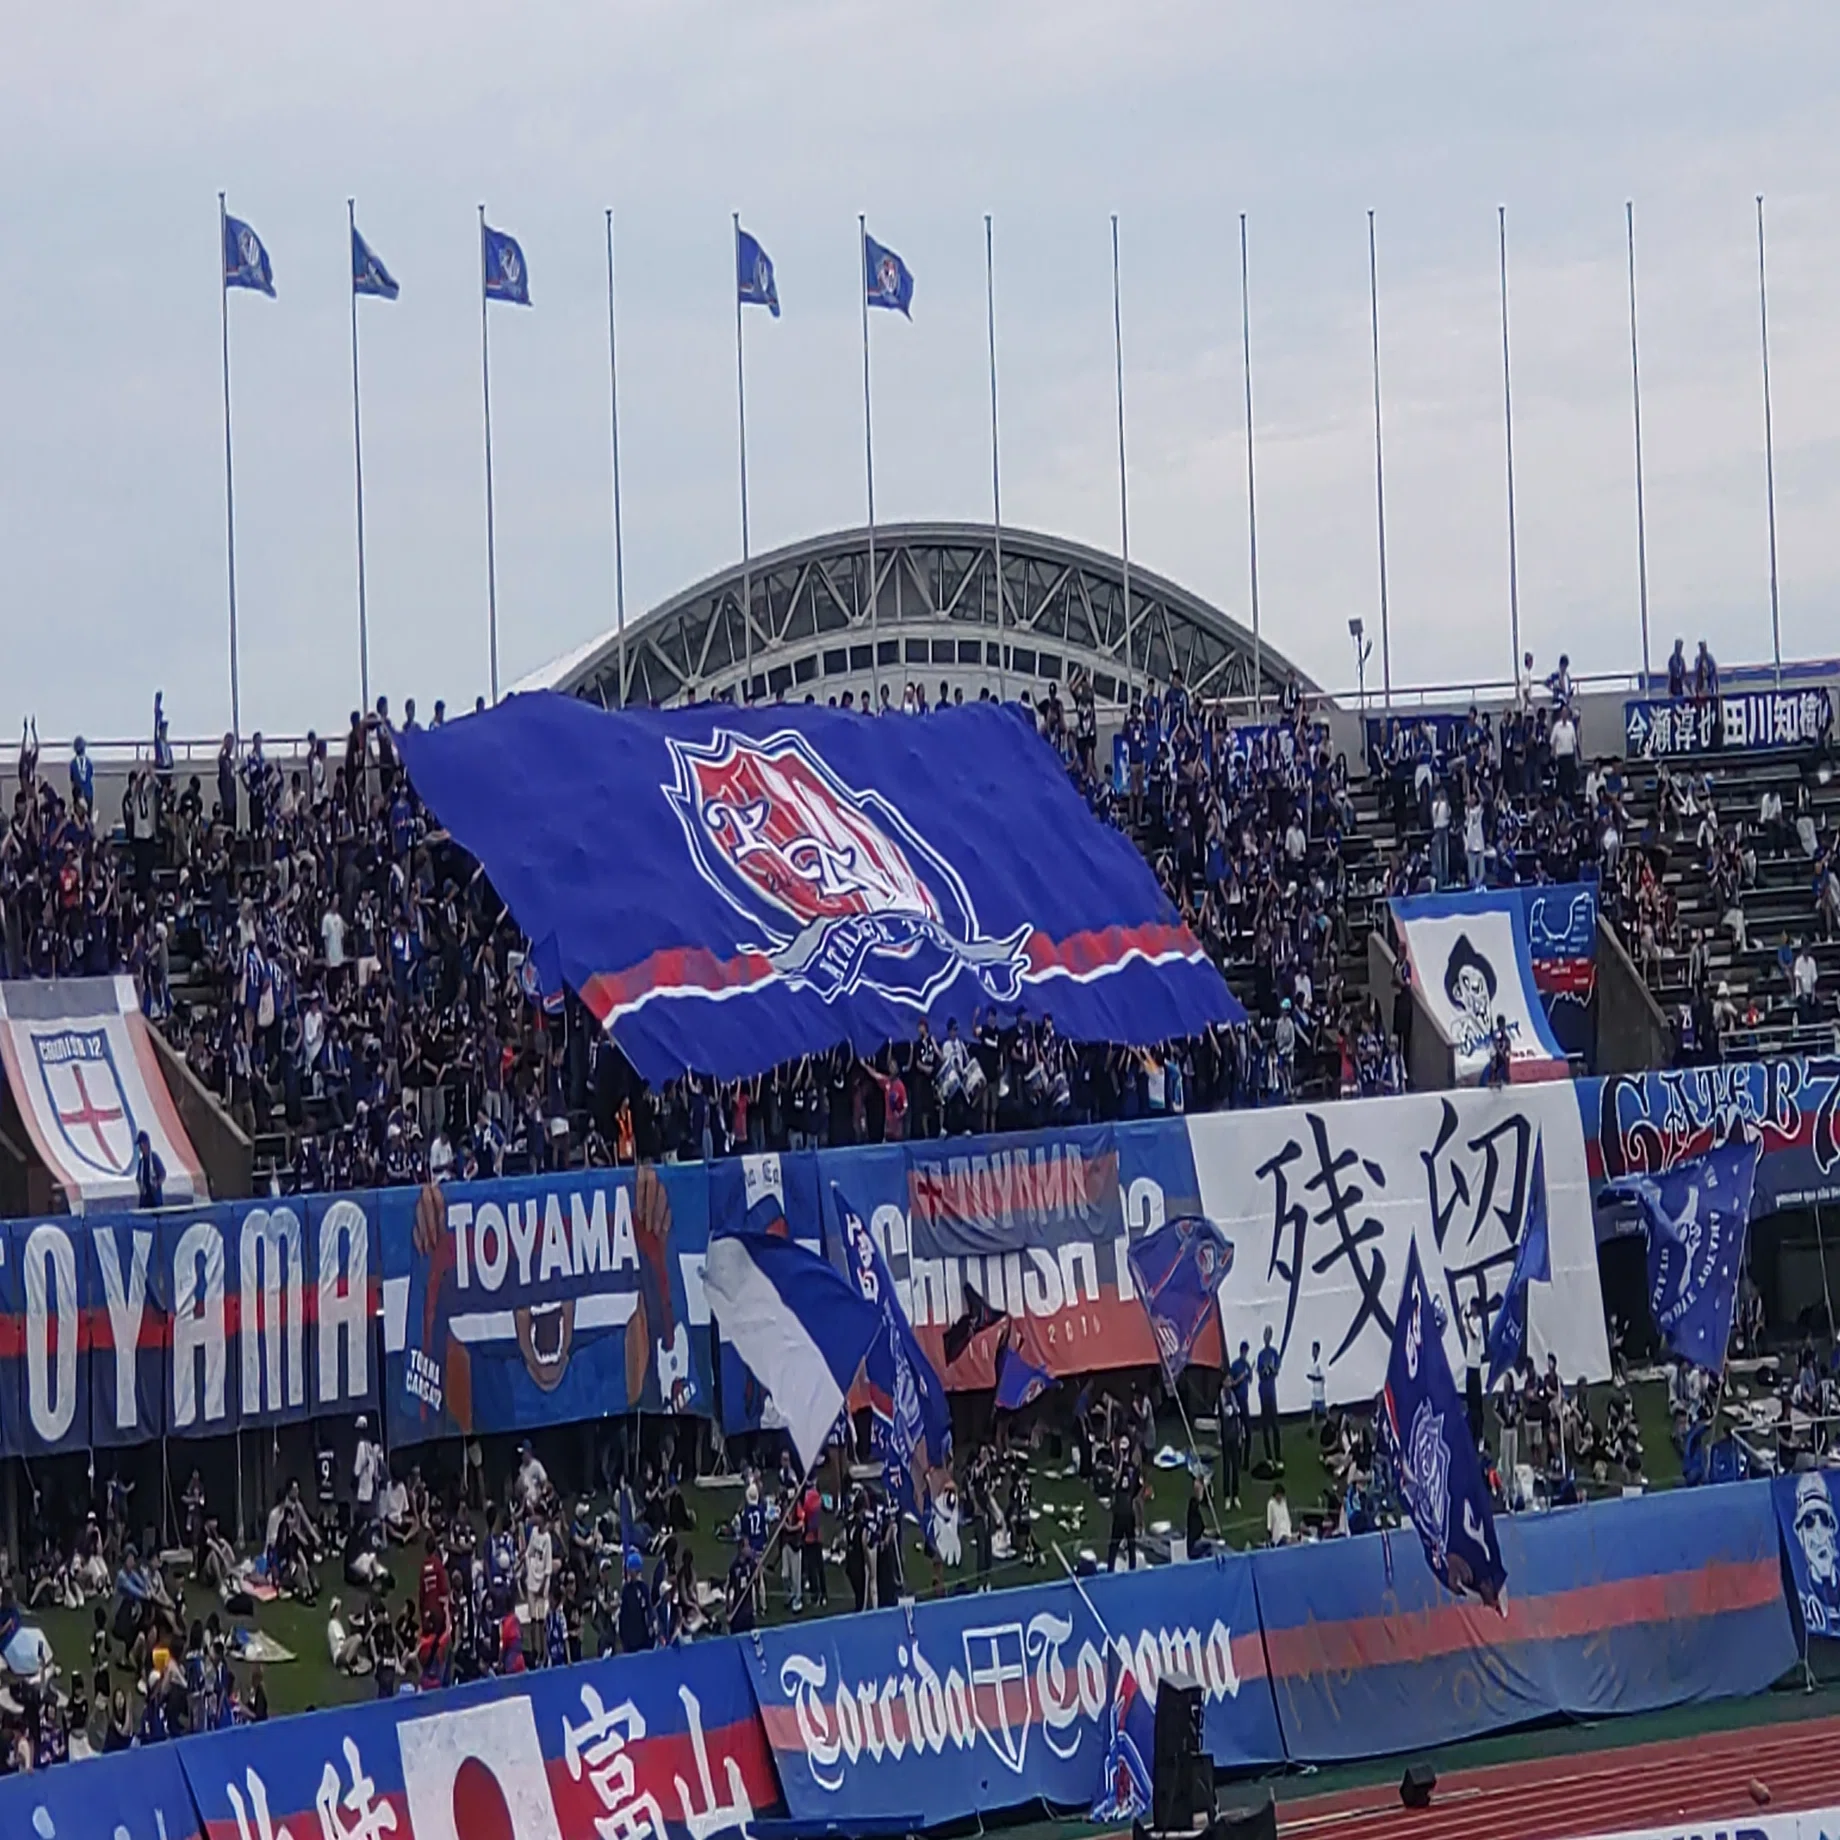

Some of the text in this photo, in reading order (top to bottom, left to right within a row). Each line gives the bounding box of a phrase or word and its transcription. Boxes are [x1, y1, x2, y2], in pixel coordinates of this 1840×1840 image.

[448, 1185, 640, 1292] TOYAMA
[1255, 1096, 1532, 1377] 残留
[0, 1208, 369, 1441] OYAMA
[748, 1510, 761, 1535] 12
[562, 1682, 755, 1840] 富山
[781, 1639, 976, 1791] Torcida
